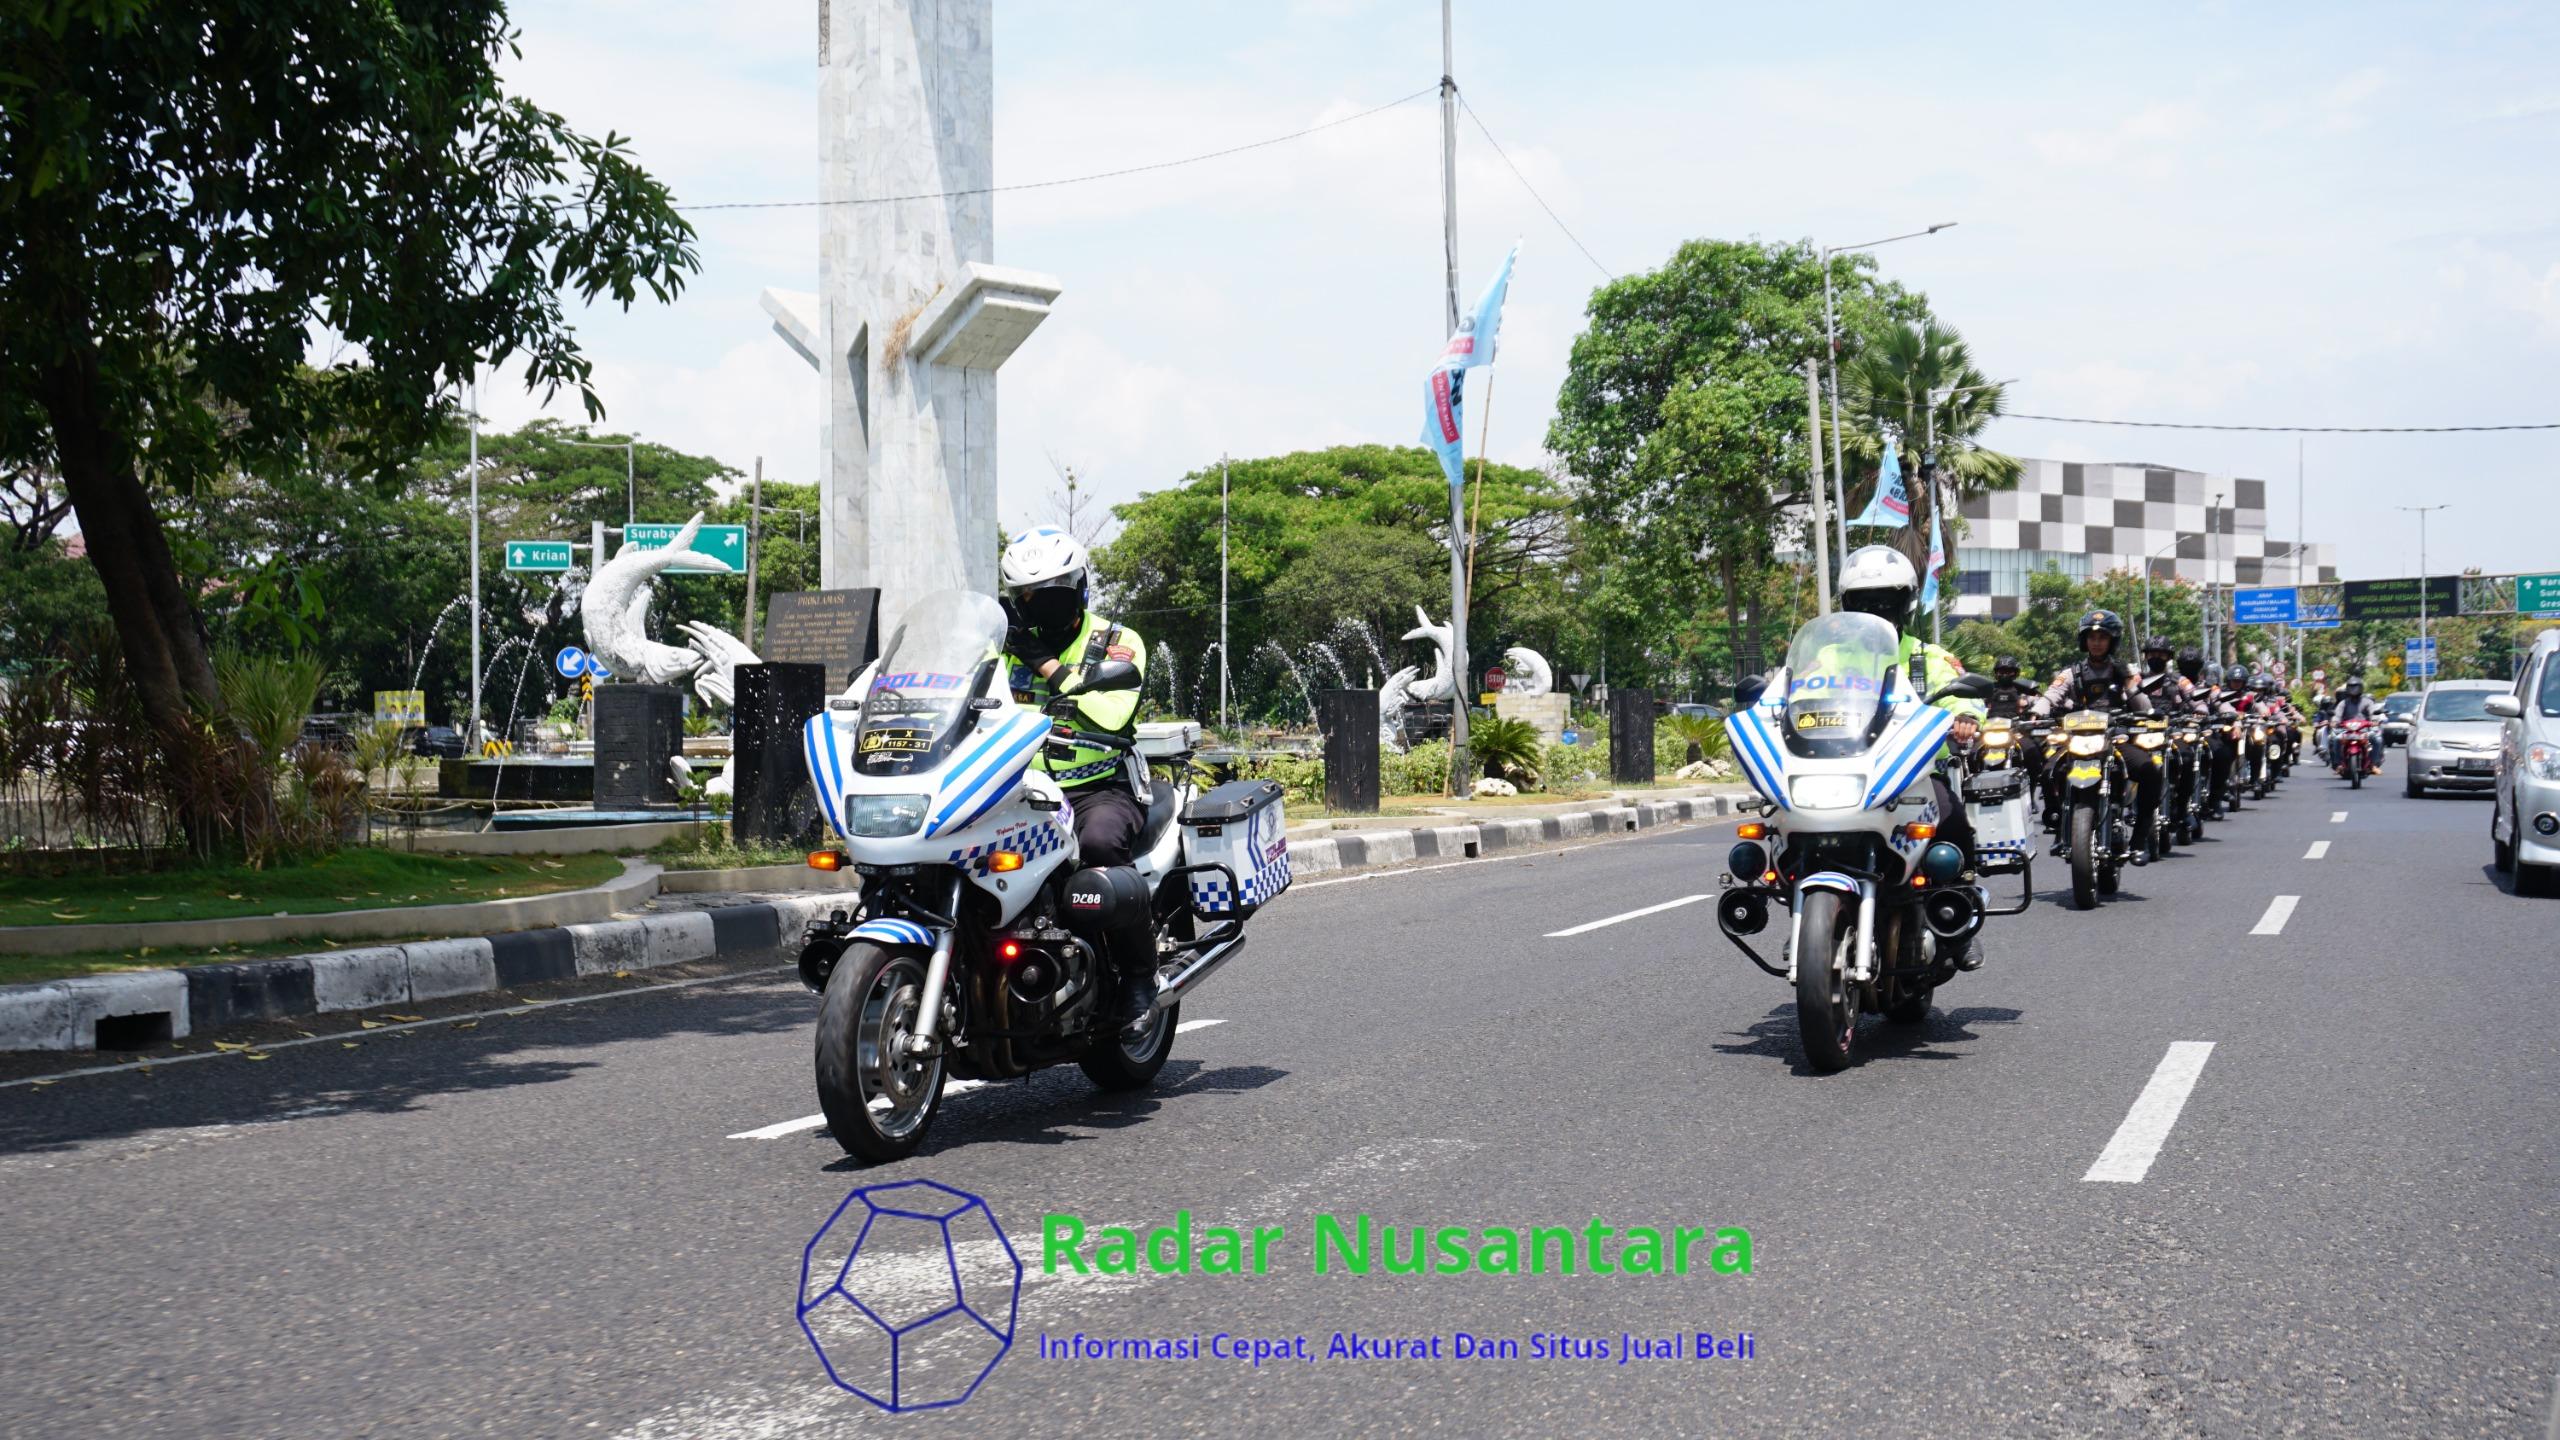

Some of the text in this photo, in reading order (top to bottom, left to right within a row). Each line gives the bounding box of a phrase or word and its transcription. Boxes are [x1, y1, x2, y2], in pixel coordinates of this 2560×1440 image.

[532, 549, 567, 561] Krian
[1488, 674, 1505, 683] STOP
[871, 672, 966, 696] POLISI
[1789, 675, 1882, 694] POLISI
[905, 730, 913, 738] X
[888, 740, 907, 748] 1157
[914, 741, 926, 749] 31
